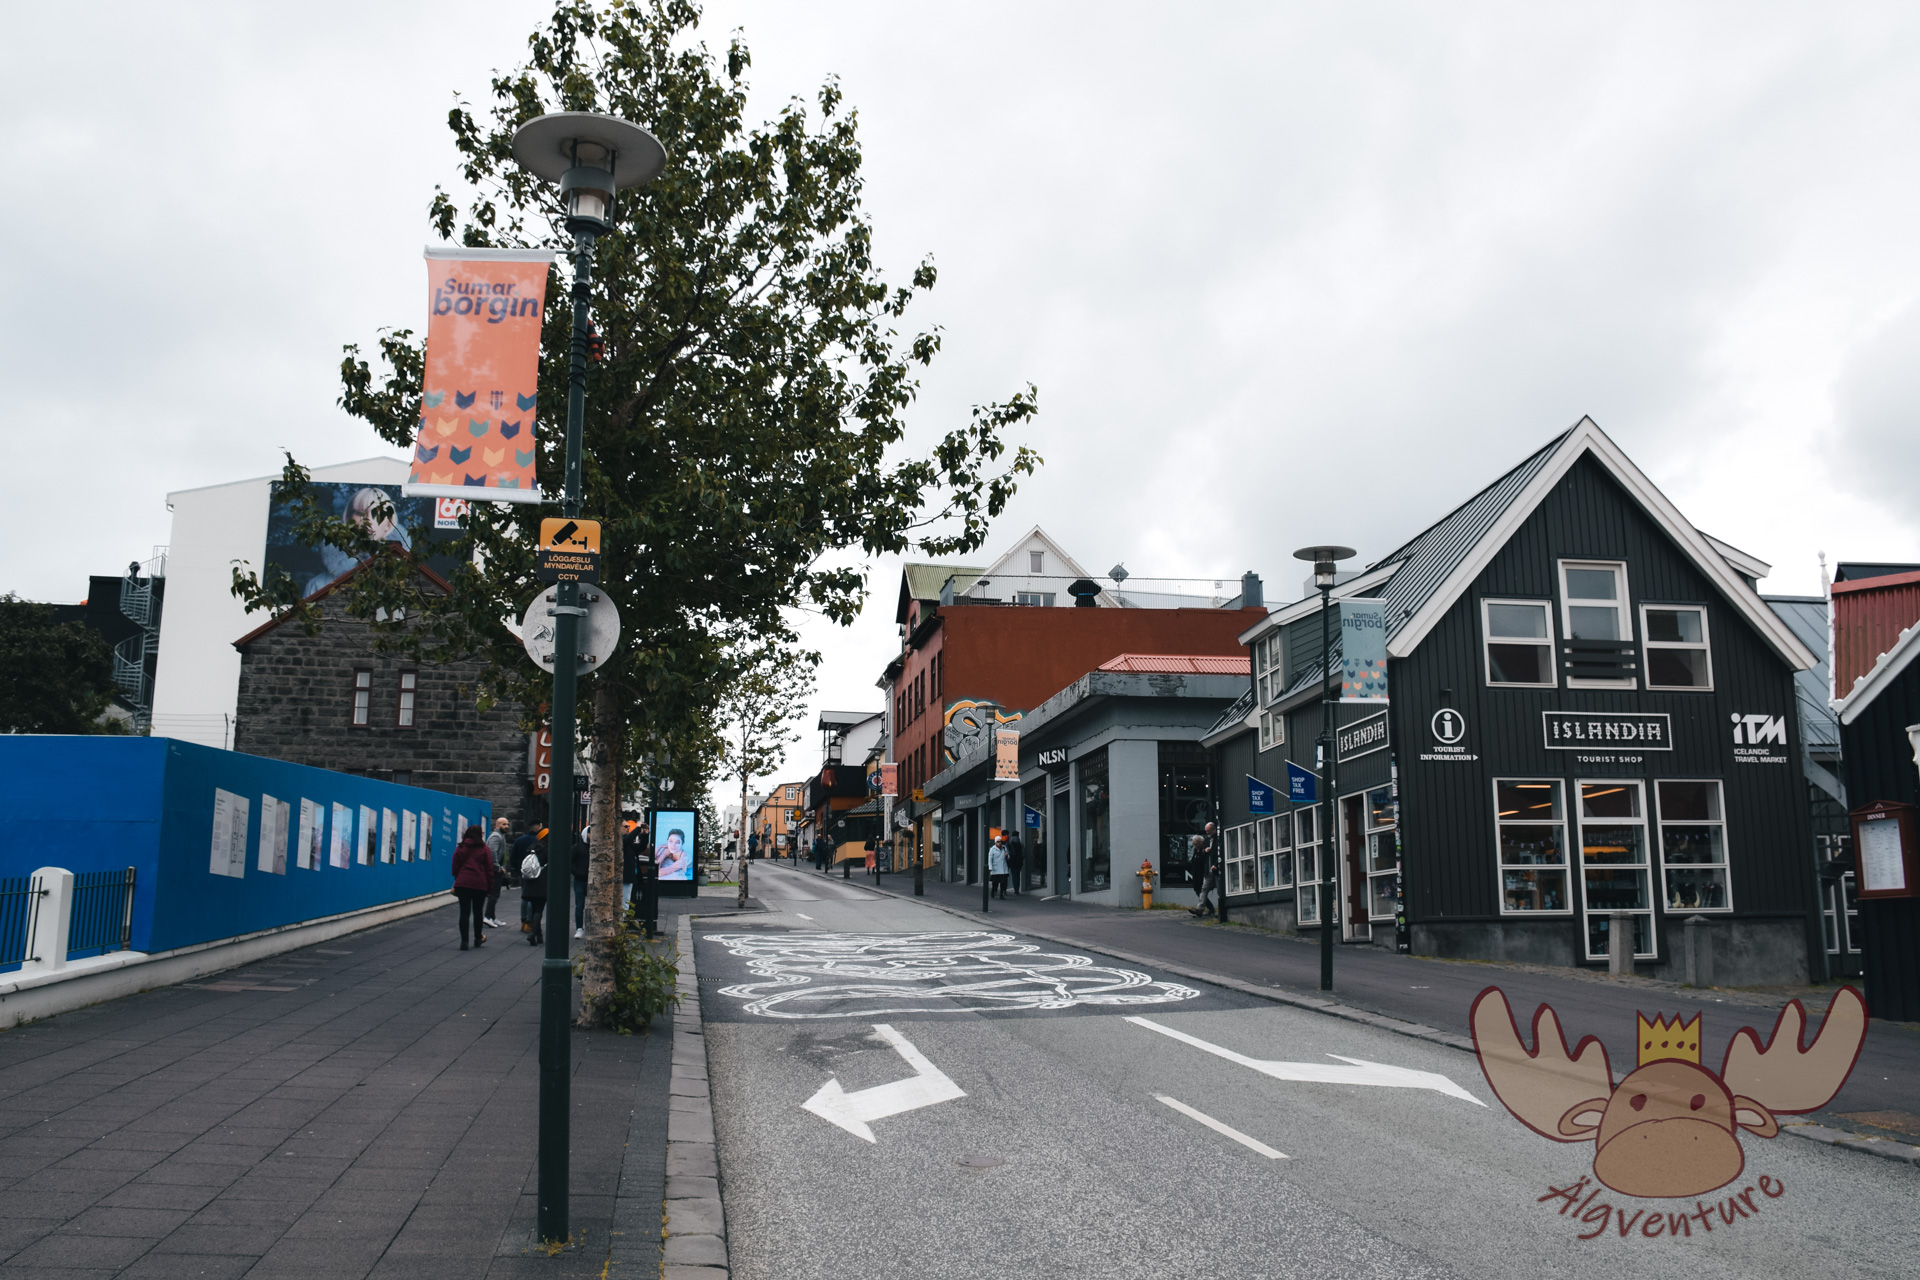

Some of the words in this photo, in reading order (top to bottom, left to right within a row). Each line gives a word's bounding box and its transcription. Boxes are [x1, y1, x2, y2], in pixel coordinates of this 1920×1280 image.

[444, 278, 516, 296] Sumar
[433, 288, 538, 324] borgin
[549, 555, 591, 564] LÖGGÆSLU
[544, 562, 594, 571] MYNDAVÉLAR
[558, 573, 579, 581] CCTV
[1553, 721, 1661, 740] ISLANDIA
[1340, 721, 1385, 753] ISLANDIA
[1038, 748, 1066, 766] NLSN
[1577, 755, 1616, 763] TOURIST
[1760, 756, 1787, 764] MARKET
[1867, 812, 1886, 820] DINNER
